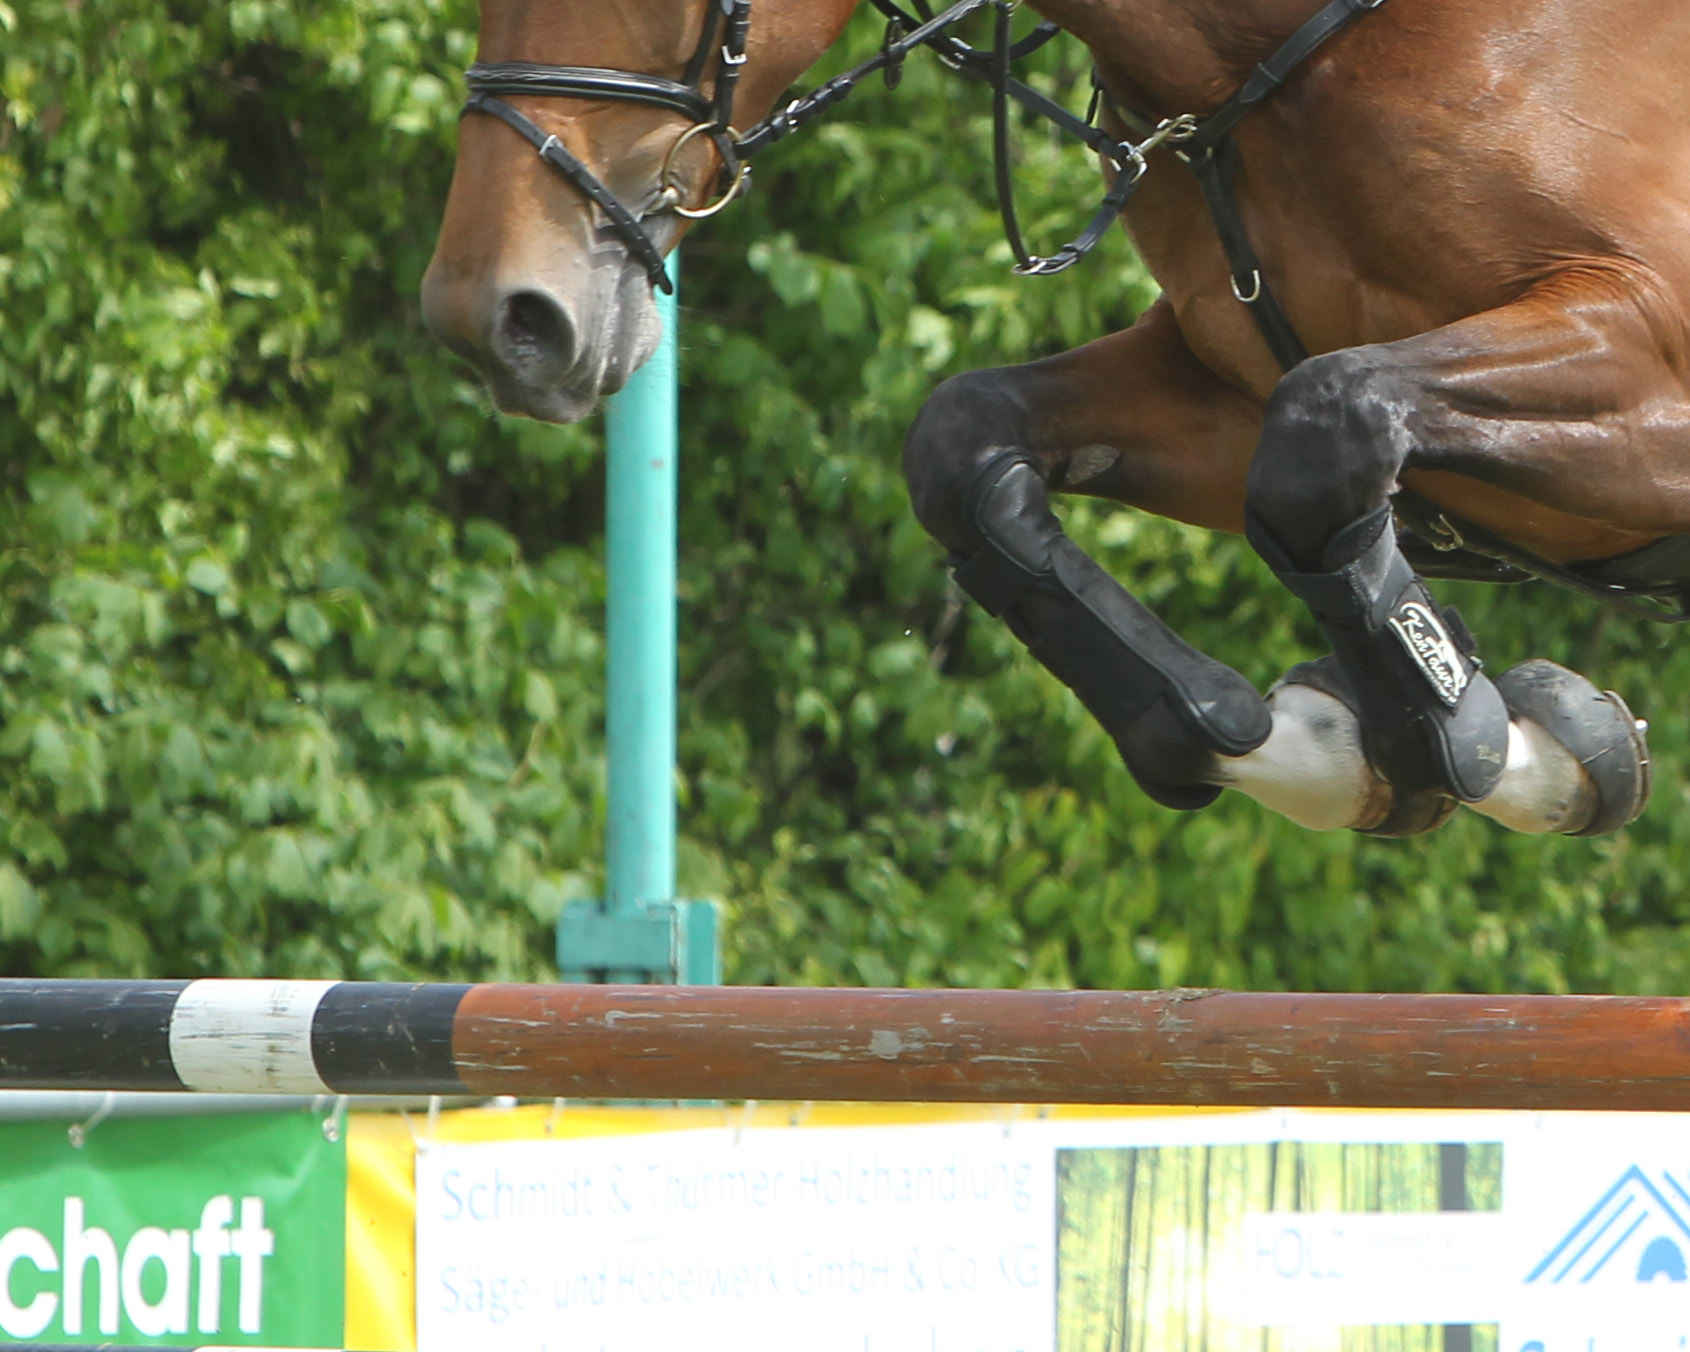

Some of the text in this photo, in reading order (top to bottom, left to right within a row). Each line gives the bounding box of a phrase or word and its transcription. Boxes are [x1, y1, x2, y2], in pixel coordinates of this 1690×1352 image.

[441, 1167, 593, 1222] Schmidt
[608, 1162, 633, 1215] &
[798, 1151, 1034, 1213] Holzhandlung
[553, 1258, 609, 1309] und
[793, 1248, 890, 1297] GmbH
